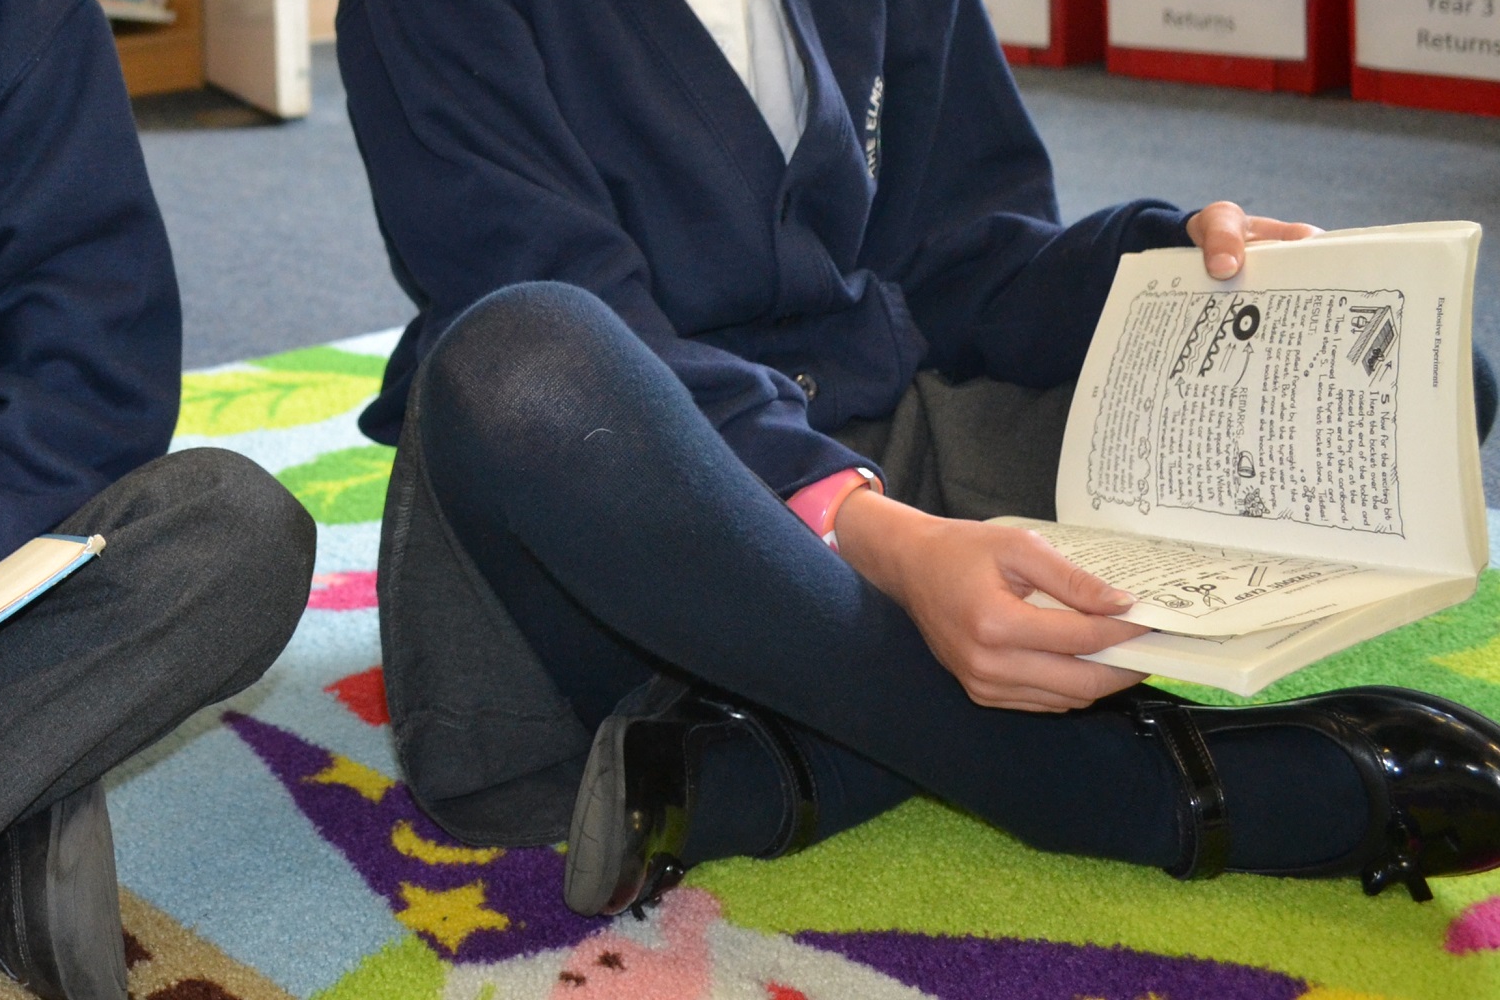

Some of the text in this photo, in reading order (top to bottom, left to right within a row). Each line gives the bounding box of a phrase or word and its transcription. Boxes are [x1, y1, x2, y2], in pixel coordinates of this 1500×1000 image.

[1162, 7, 1237, 33] Returns
[1417, 27, 1500, 58] Returns
[865, 76, 883, 131] ELMS
[1282, 295, 1293, 326] removed
[1292, 295, 1301, 318] water
[1303, 296, 1313, 311] The
[1339, 297, 1347, 307] 6
[1308, 295, 1322, 336] RESULT:
[1324, 295, 1336, 332] repeated
[1333, 315, 1345, 335] Then
[1279, 331, 1287, 344] the
[1319, 337, 1330, 354] step
[1433, 297, 1445, 388] Explosive Experiments
[1282, 349, 1293, 380] bucket.
[1293, 349, 1301, 371] pulled
[1328, 345, 1337, 379] removed
[1229, 387, 1238, 409] When
[1282, 384, 1290, 398] But
[1290, 375, 1299, 408] forward
[1317, 374, 1327, 402] Leave
[1328, 384, 1336, 397] the
[1381, 394, 1390, 404] 5
[1326, 402, 1334, 423] tyres
[1336, 389, 1344, 422] opposite
[1367, 399, 1378, 416] hung
[1226, 412, 1234, 440] rubber
[1288, 412, 1295, 422] by
[1369, 421, 1378, 434] the
[1380, 411, 1390, 430] Now
[1316, 428, 1324, 458] bucket
[1337, 445, 1345, 456] of
[1346, 439, 1354, 453] toy
[1380, 435, 1389, 448] for
[1277, 444, 1285, 466] tyres
[1286, 444, 1295, 471] weight
[1370, 439, 1378, 468] bucket
[1222, 468, 1231, 478] go
[1289, 475, 1298, 485] of
[1349, 474, 1355, 485] at
[1269, 485, 1277, 510] bumps.
[1358, 451, 1366, 462] of
[1362, 511, 1370, 526] and
[1380, 472, 1389, 504] exciting
[1318, 490, 1328, 521] Tiddles!
[1338, 478, 1348, 524] cardboard.
